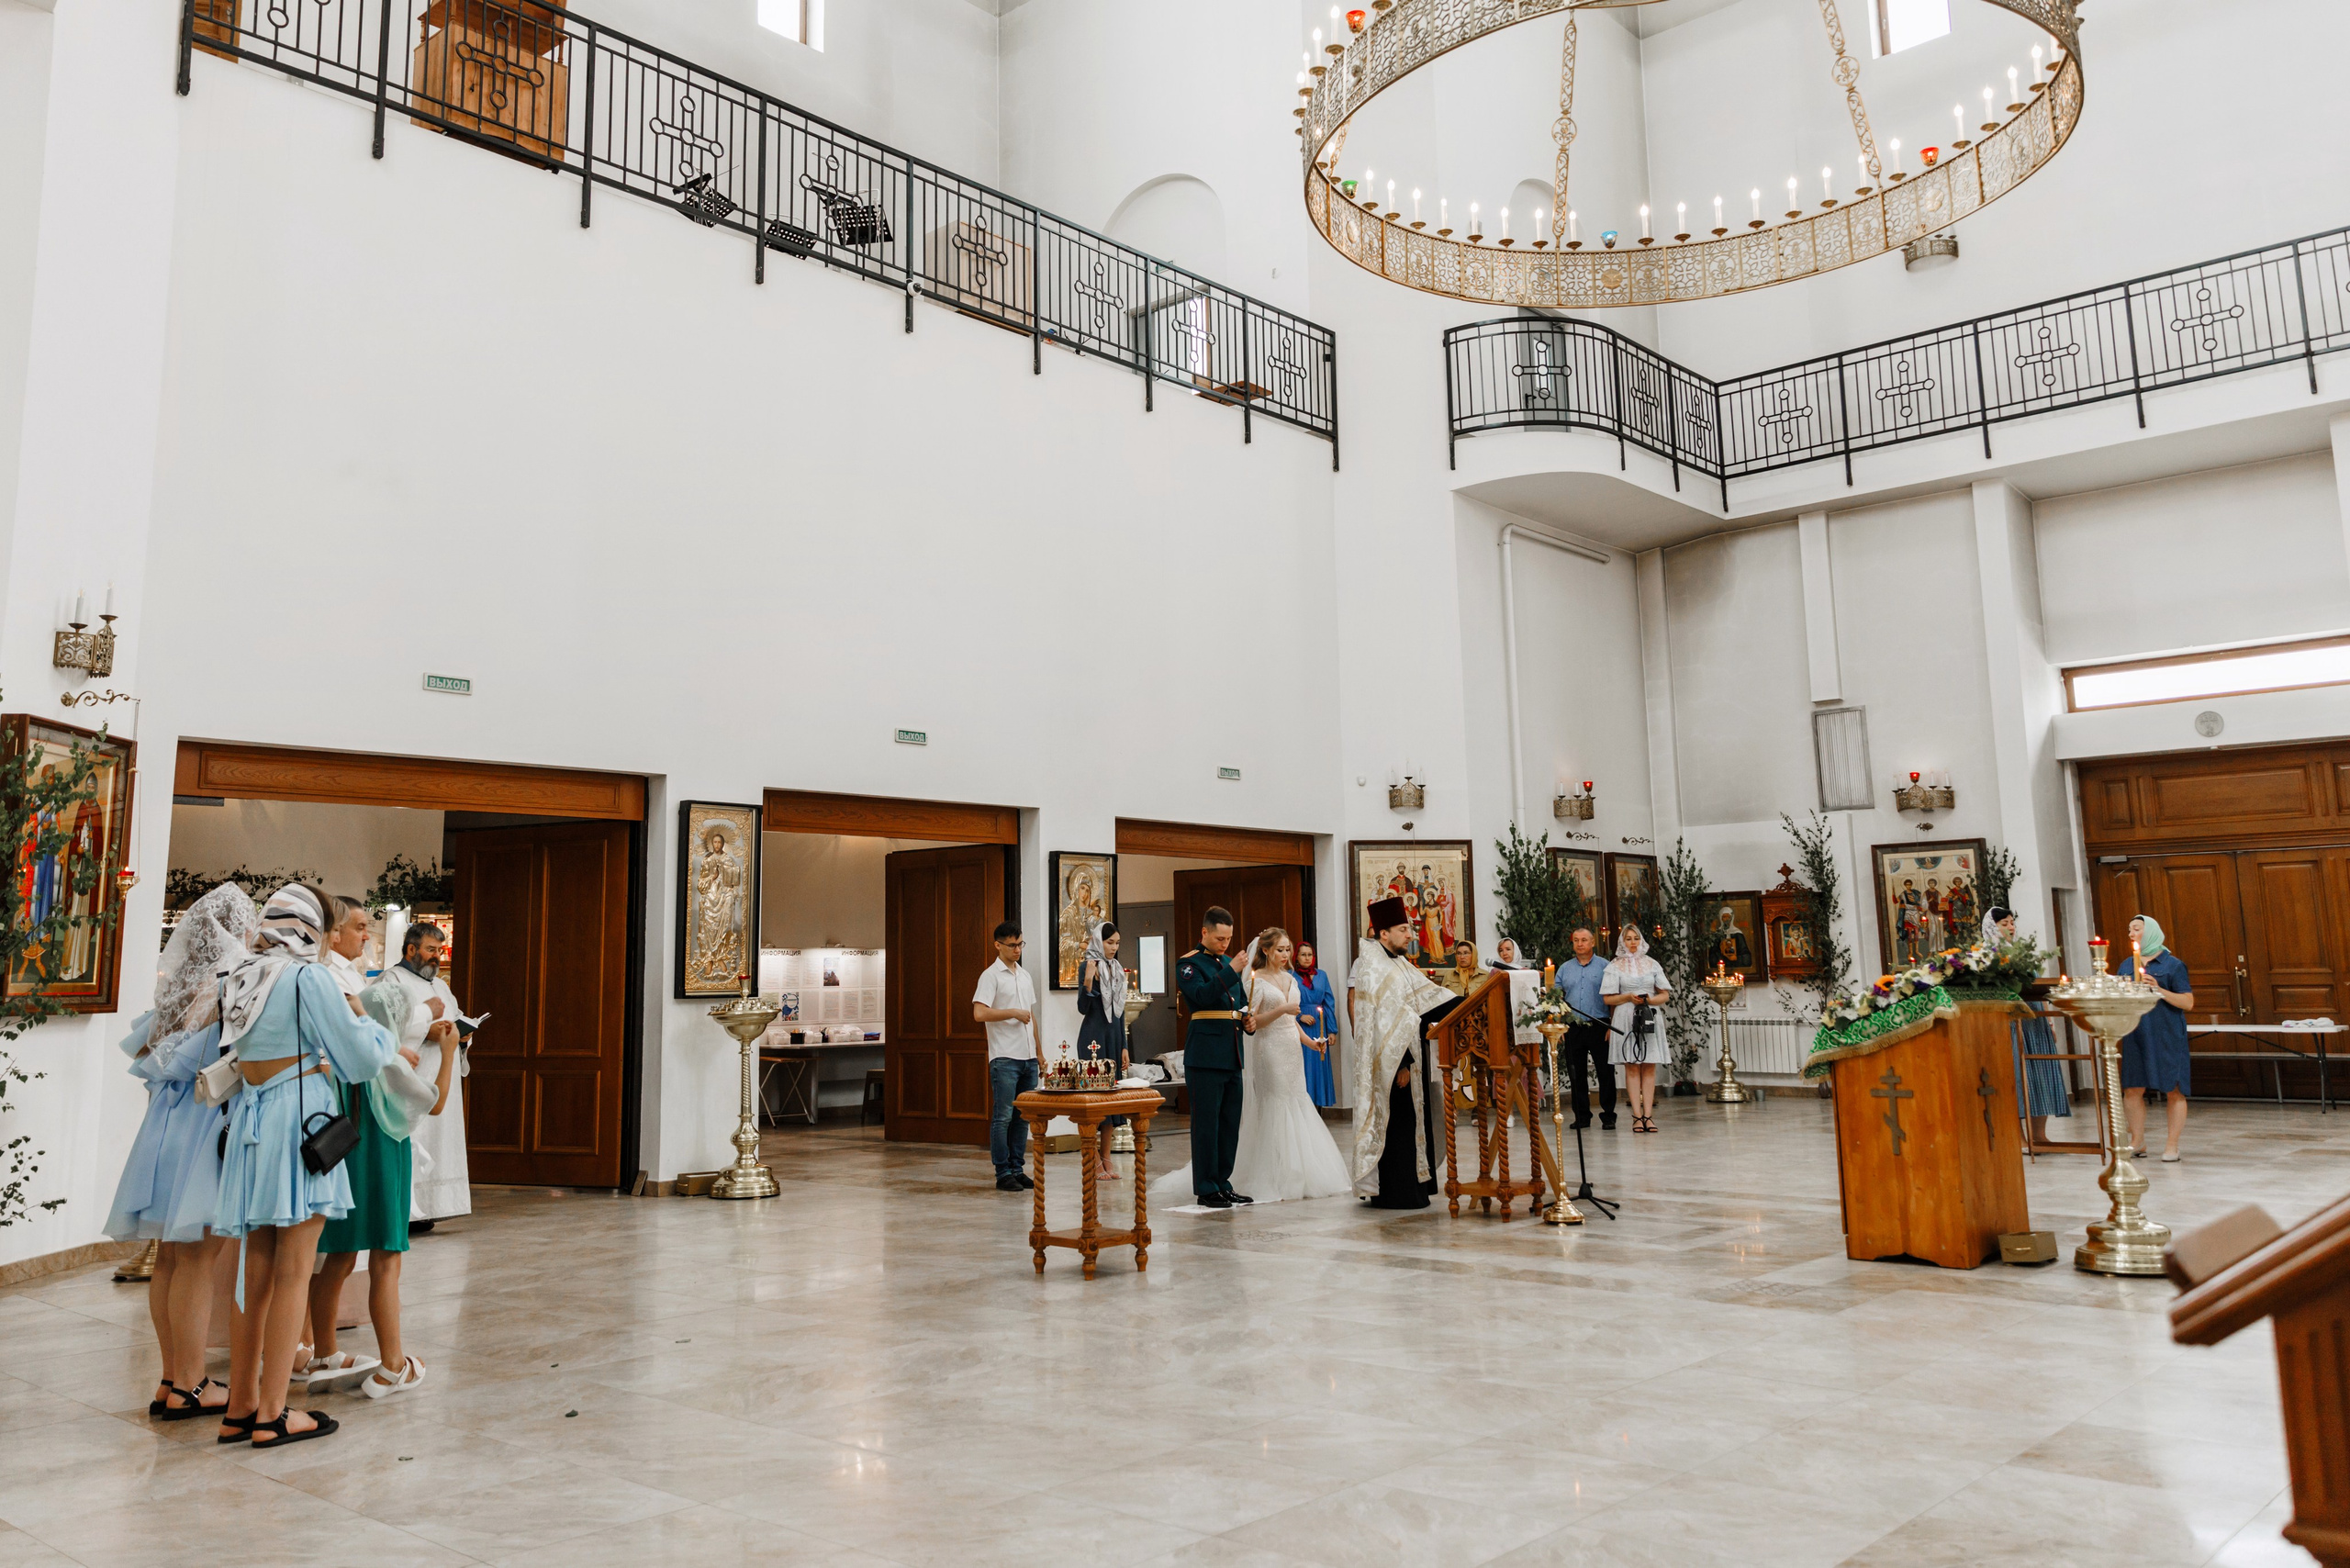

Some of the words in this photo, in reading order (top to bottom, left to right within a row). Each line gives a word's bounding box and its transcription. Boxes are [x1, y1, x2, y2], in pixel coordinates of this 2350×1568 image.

[429, 677, 468, 691] ВЫХОД
[899, 732, 925, 743] ВЫХОД
[1221, 769, 1239, 778] ВЫХОД
